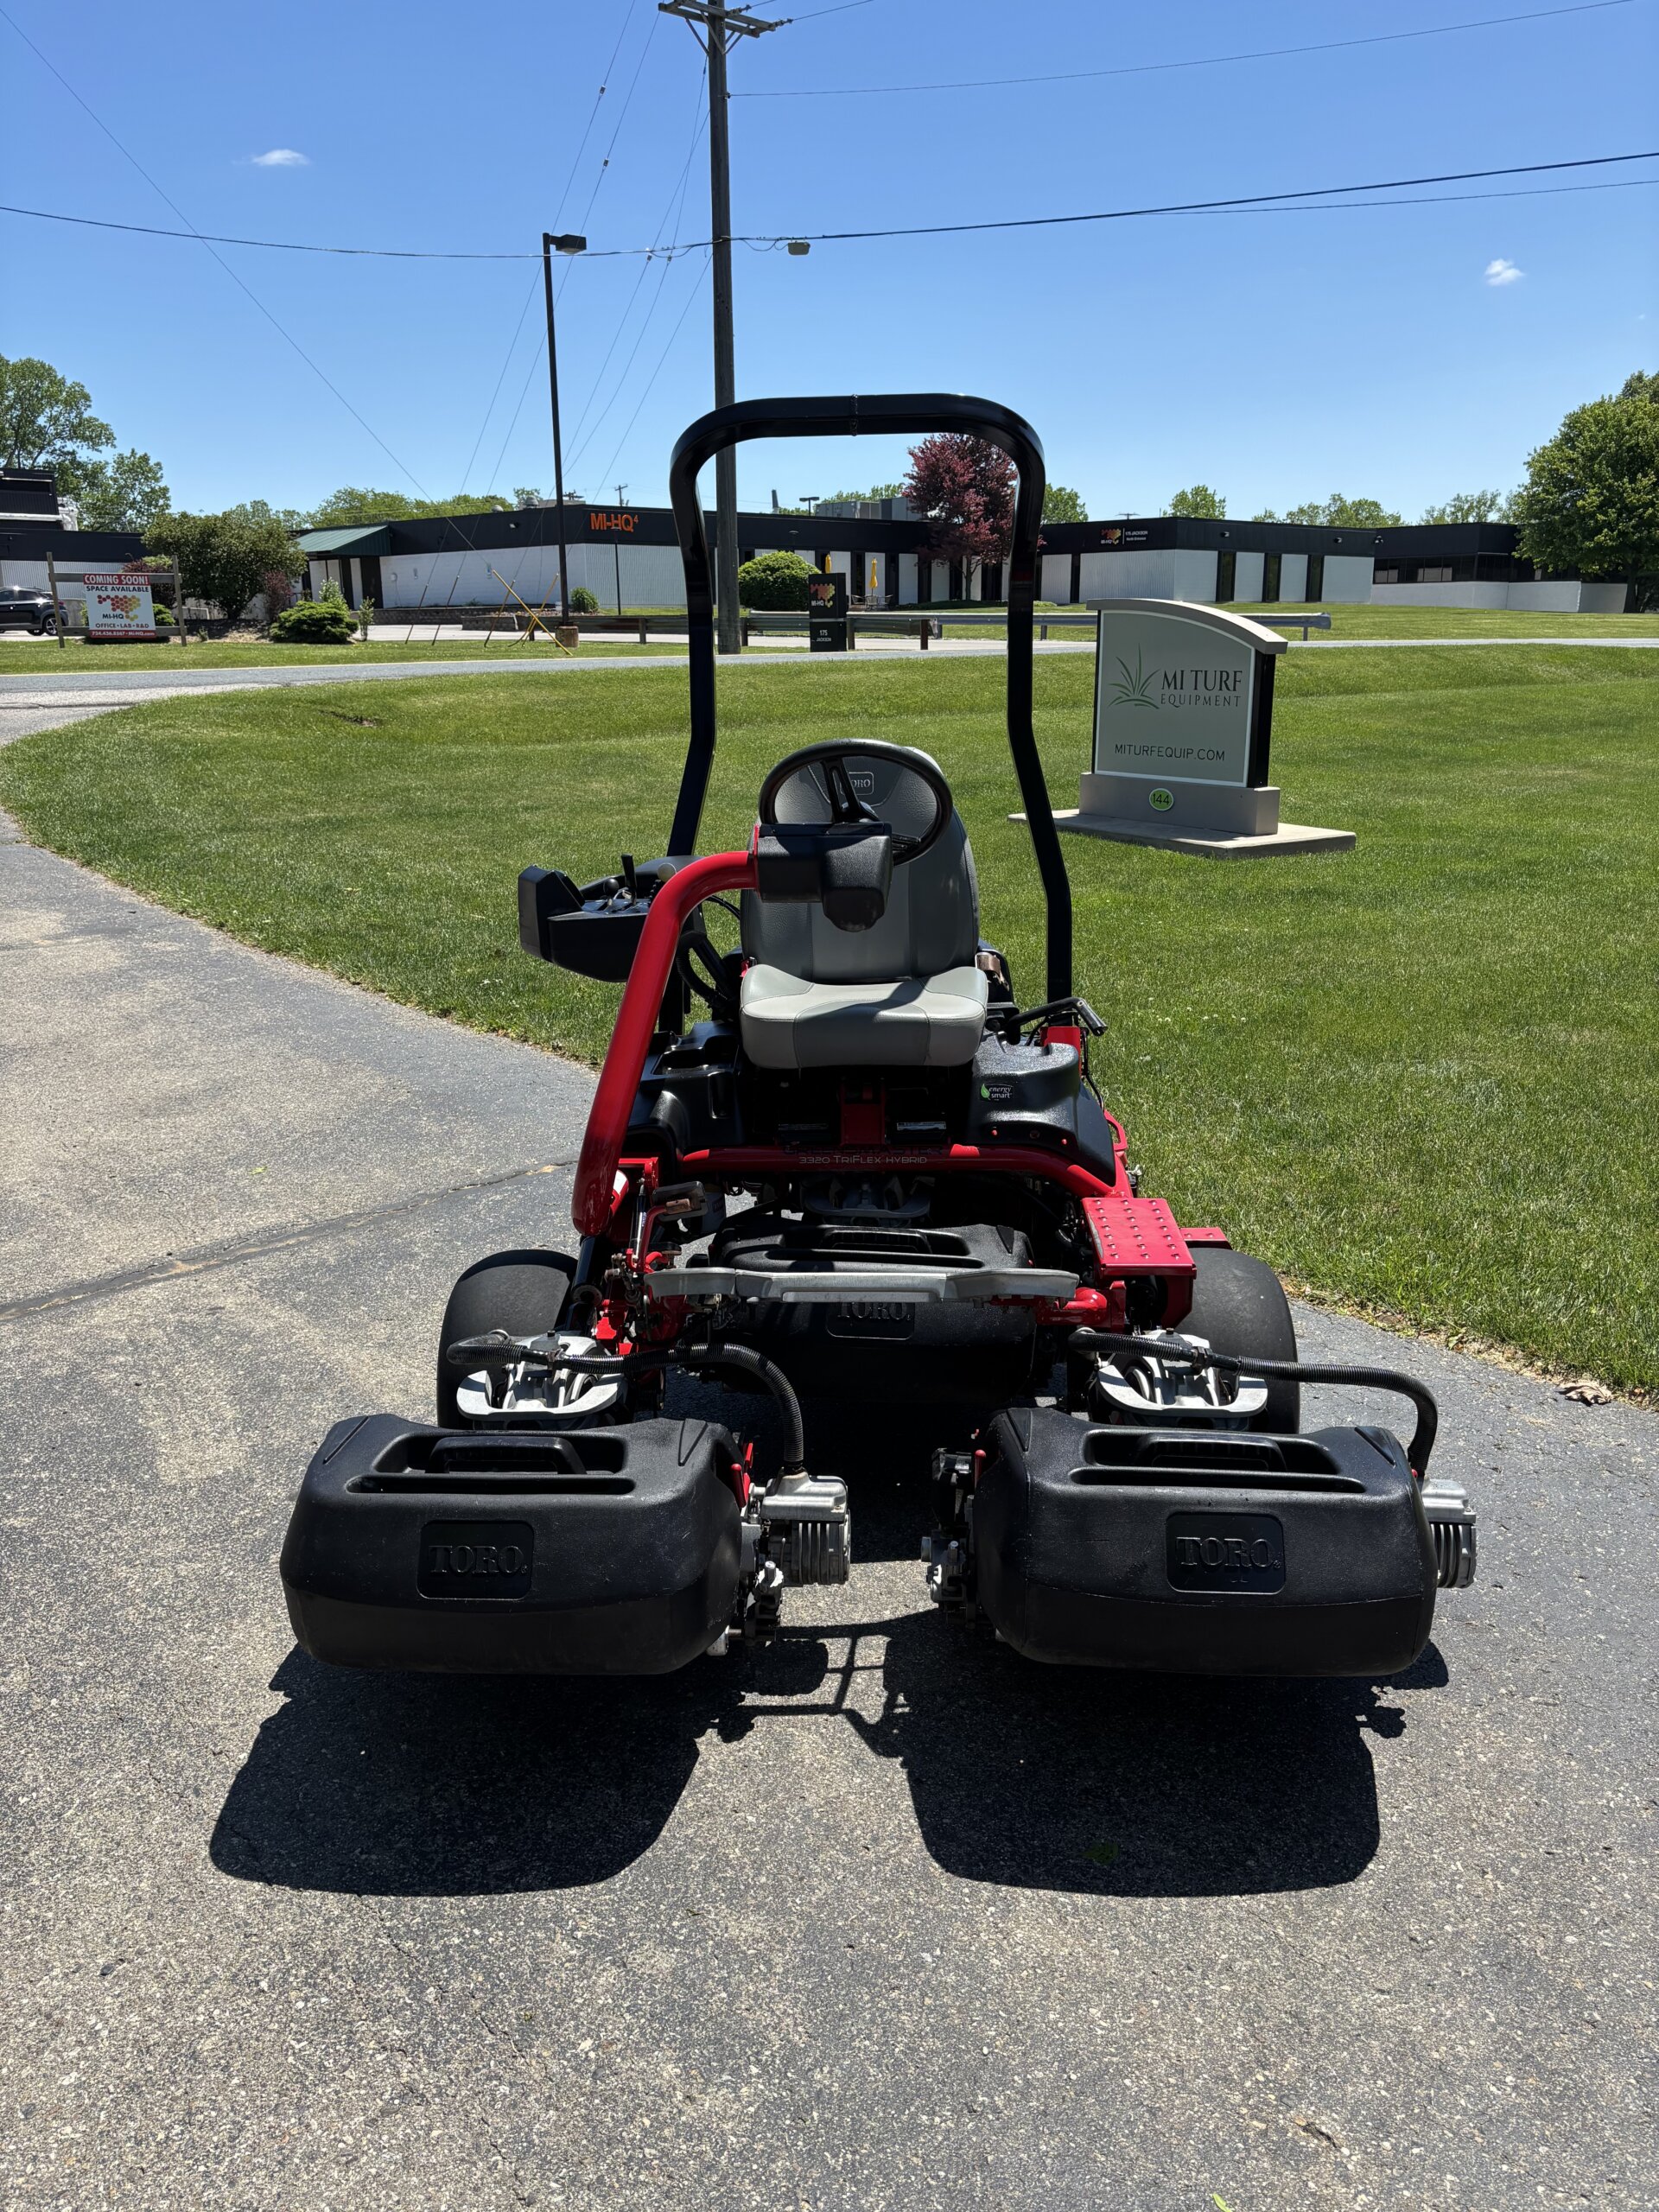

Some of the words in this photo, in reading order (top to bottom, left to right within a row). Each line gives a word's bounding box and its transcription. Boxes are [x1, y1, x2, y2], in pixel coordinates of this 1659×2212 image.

[84, 575, 119, 584] COMING
[121, 575, 149, 585] SOON!
[1161, 670, 1185, 691] MI
[1191, 670, 1243, 692] TURF
[1160, 693, 1242, 709] EQUIPMENT
[1115, 744, 1225, 761] MITURFEQUIP.COM
[850, 779, 871, 788] ORO
[1153, 793, 1170, 805] 144
